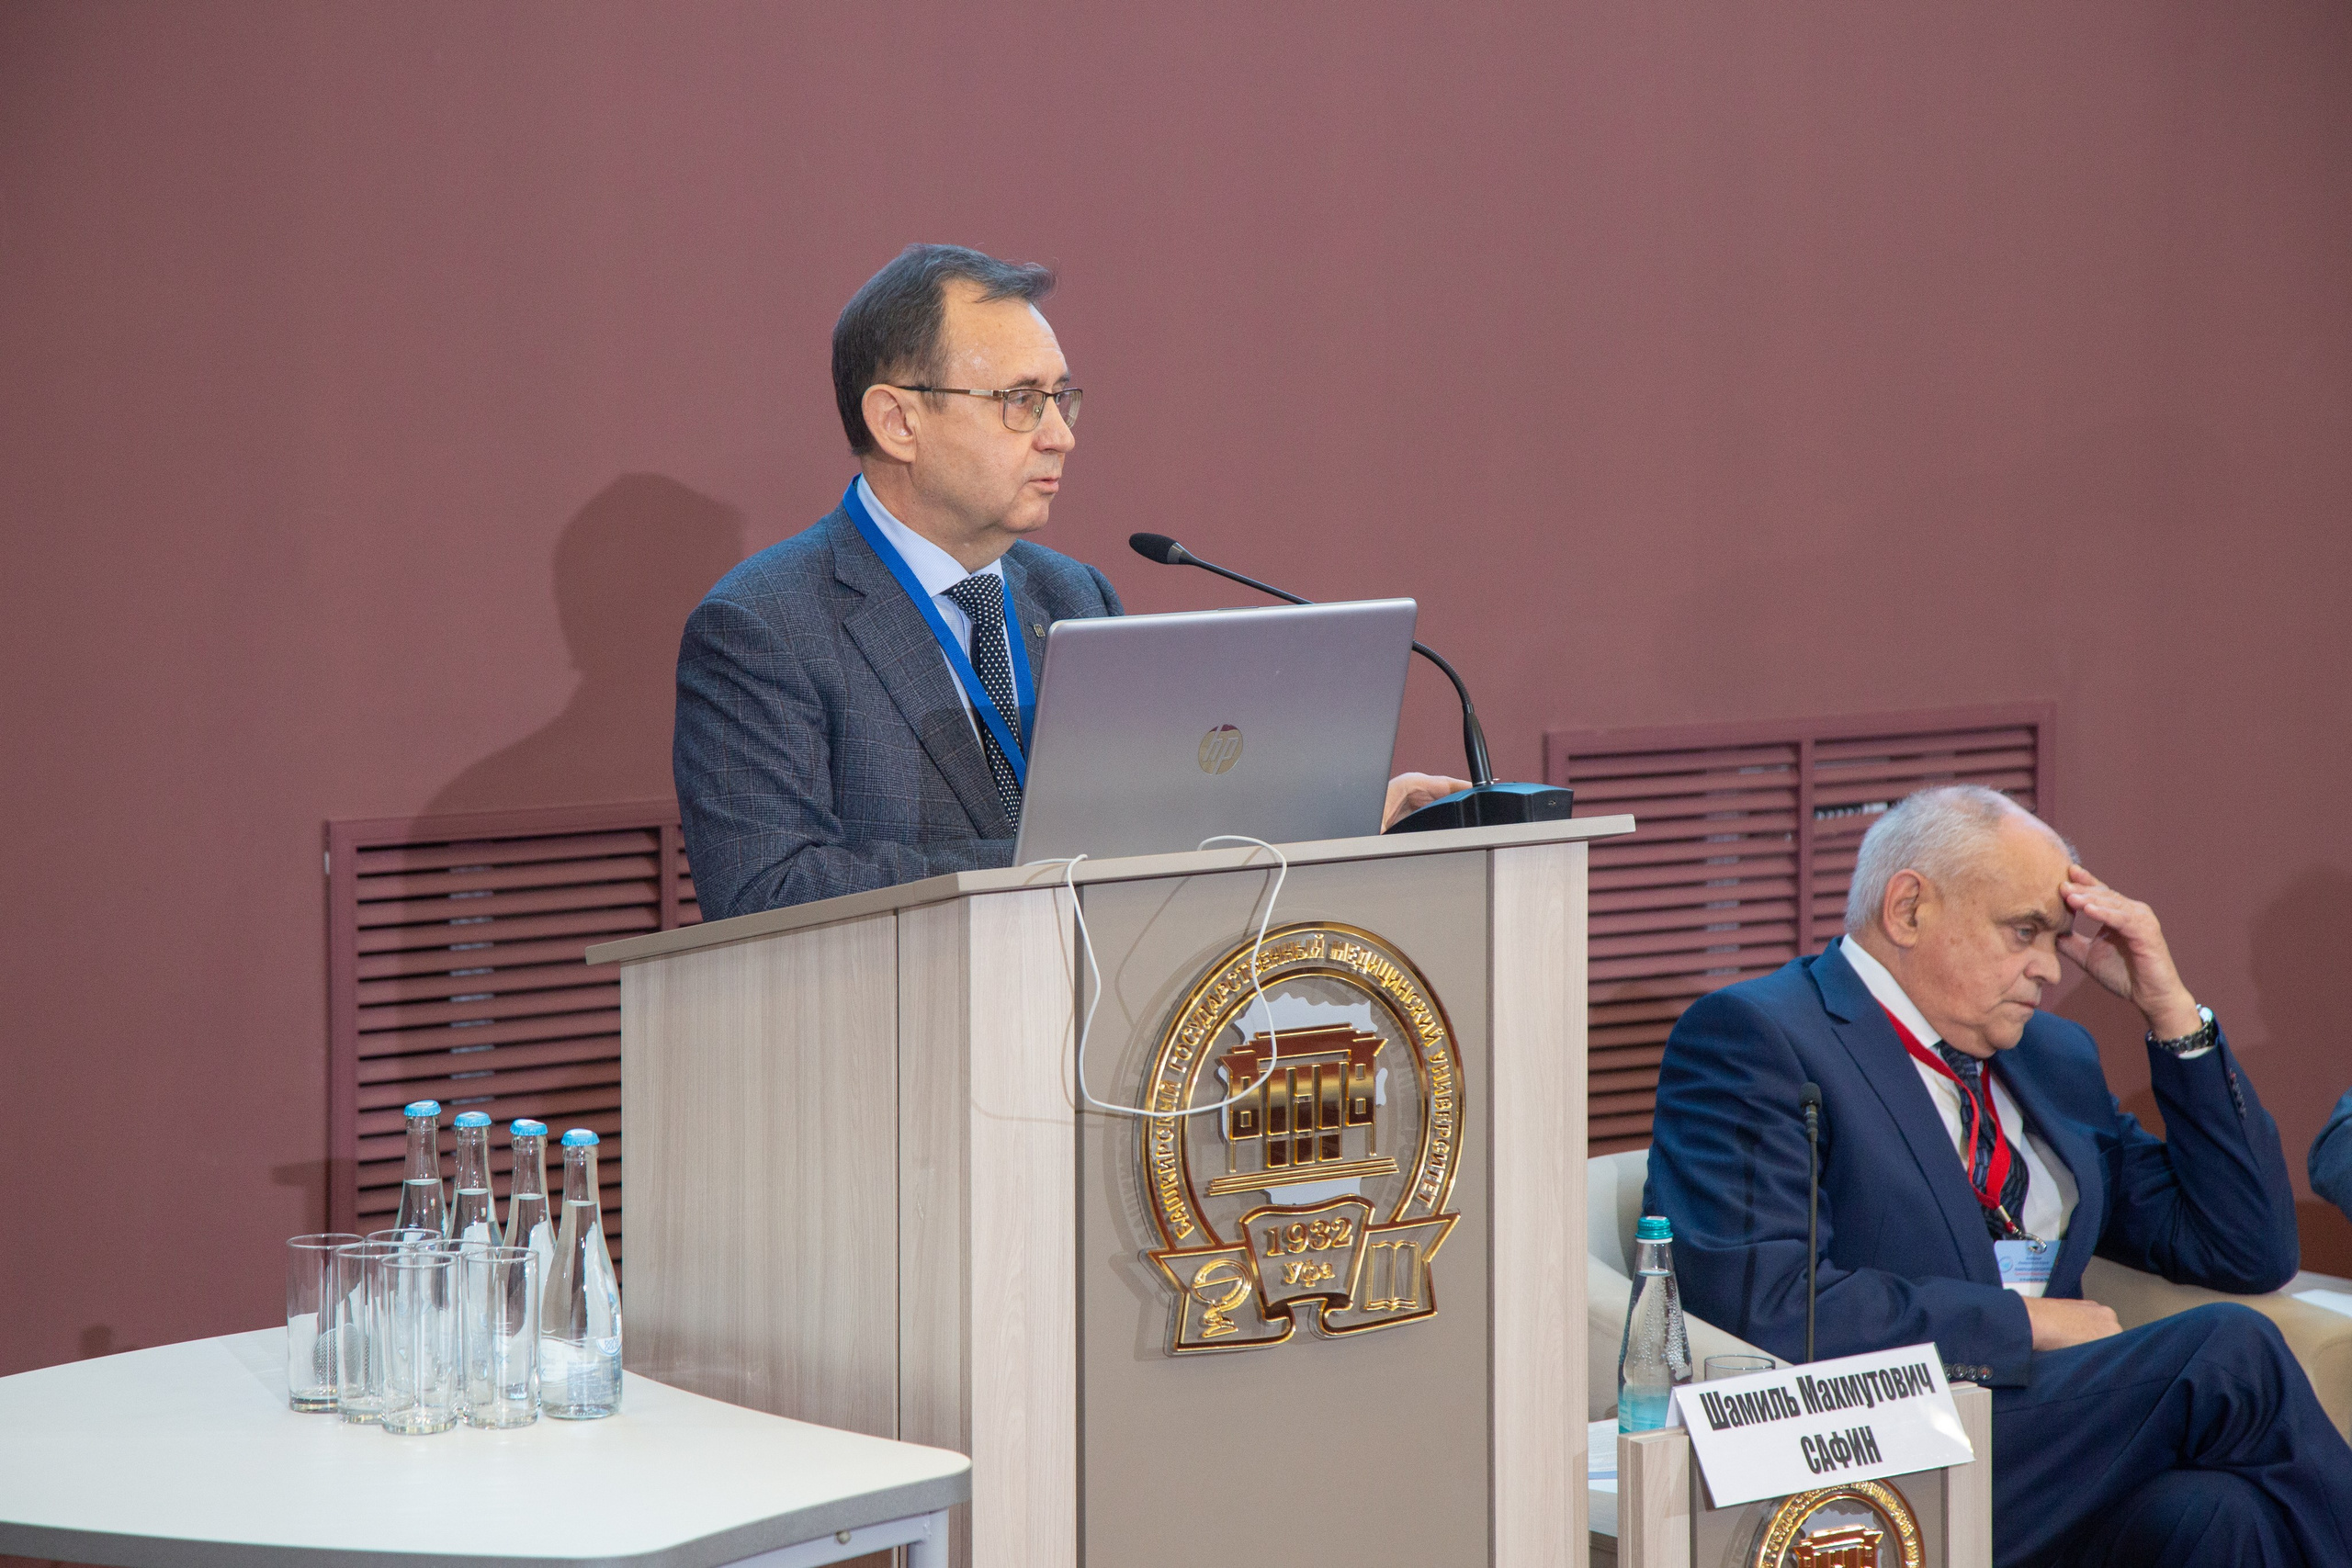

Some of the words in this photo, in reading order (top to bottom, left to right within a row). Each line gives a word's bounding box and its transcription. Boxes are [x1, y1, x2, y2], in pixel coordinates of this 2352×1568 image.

[1201, 724, 1240, 775] hp
[1329, 940, 1445, 1048] МЕДИЦИНСКИЙ
[1417, 1048, 1453, 1210] УНИВЕРСИТЕТ
[1266, 1217, 1354, 1257] 1932
[1283, 1258, 1336, 1288] Уфа
[1699, 1385, 1802, 1431] Шамиль
[1795, 1361, 1937, 1416] Махмутович
[1800, 1425, 1883, 1475] САФИН
